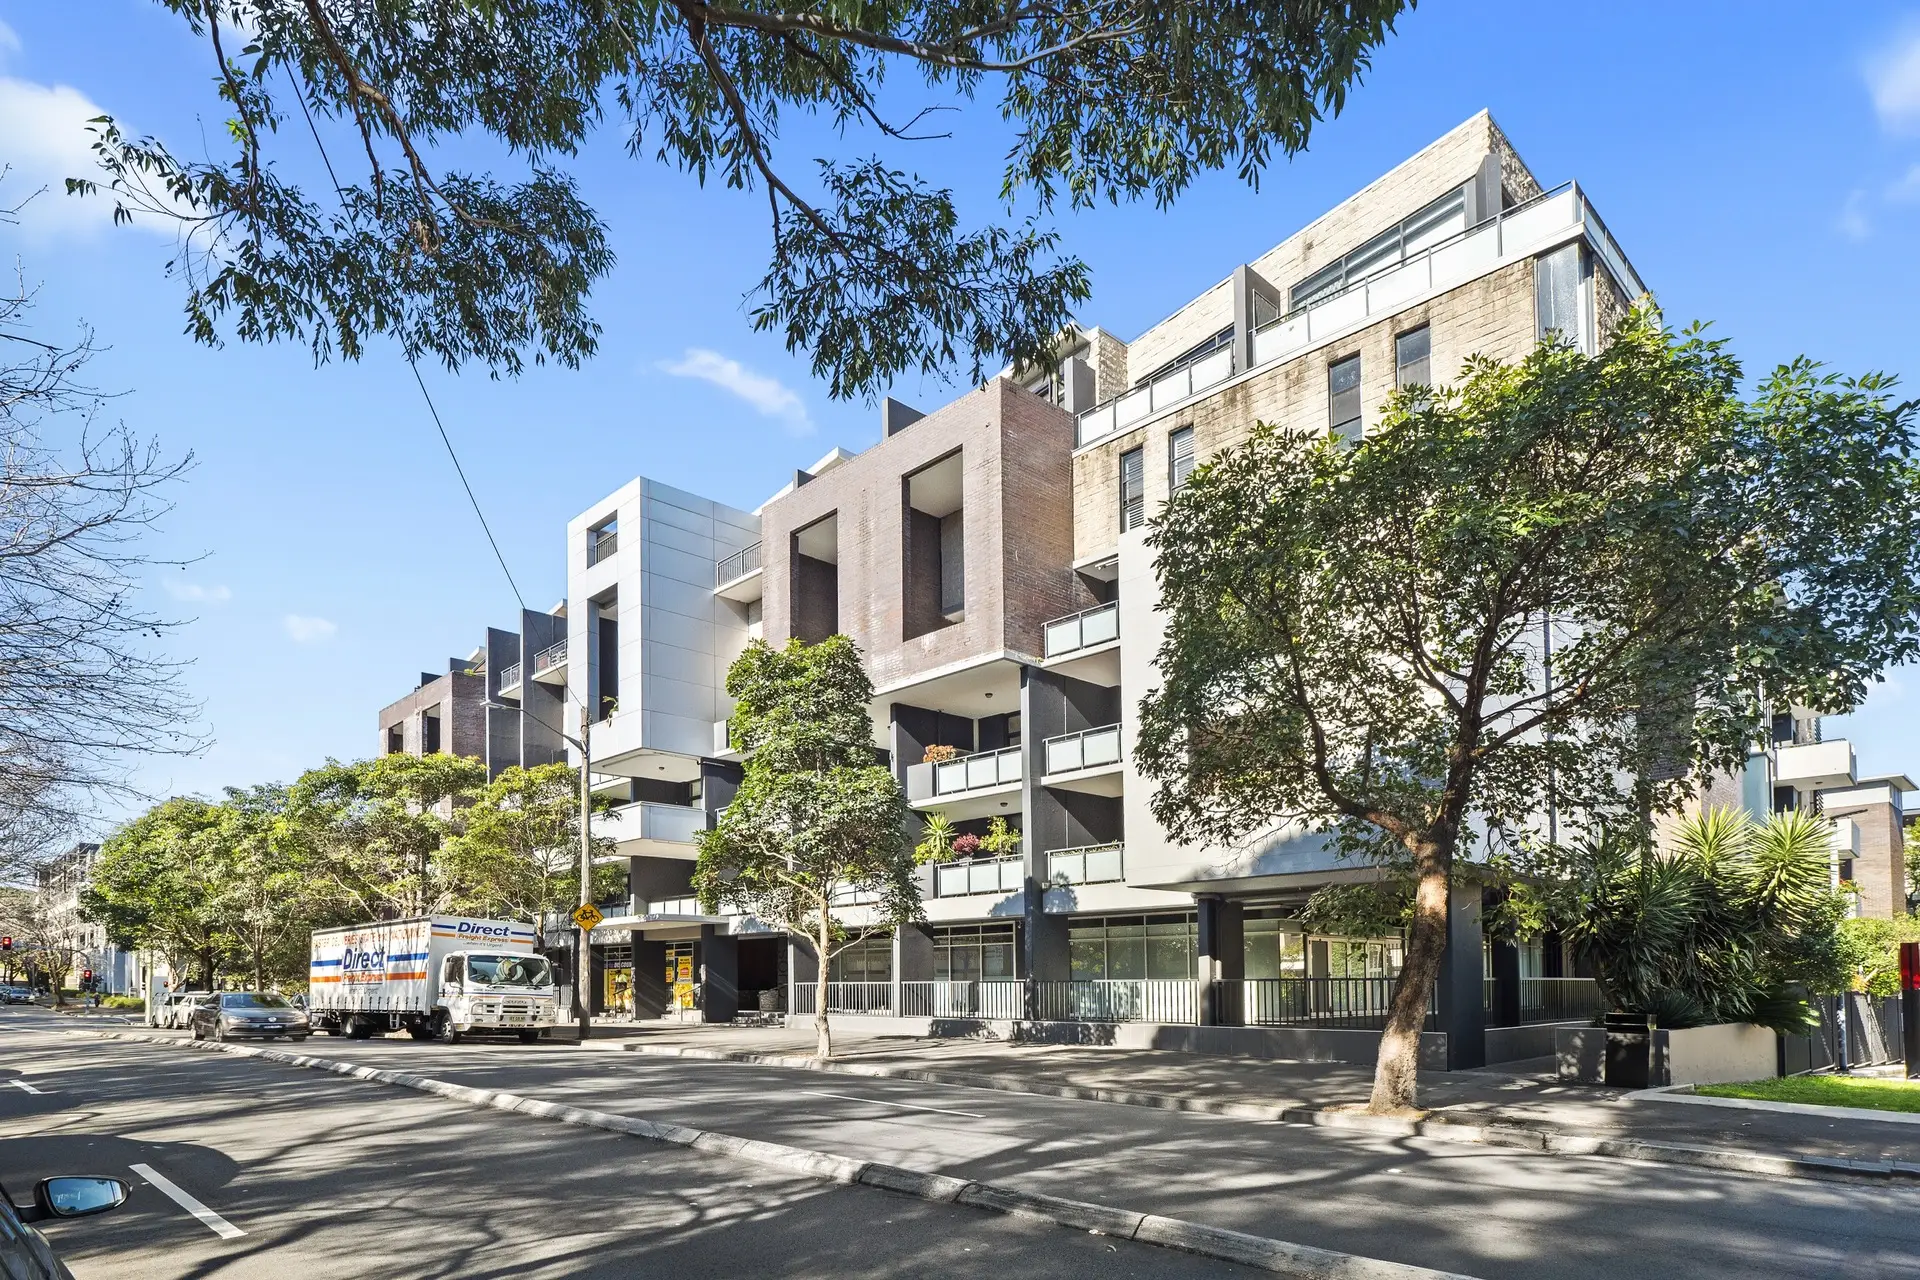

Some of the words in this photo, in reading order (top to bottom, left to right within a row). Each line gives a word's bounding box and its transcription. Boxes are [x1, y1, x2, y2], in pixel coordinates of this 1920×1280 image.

[457, 922, 510, 936] Direct
[458, 933, 482, 941] Freight
[482, 935, 508, 943] Express
[343, 947, 385, 970] Direct
